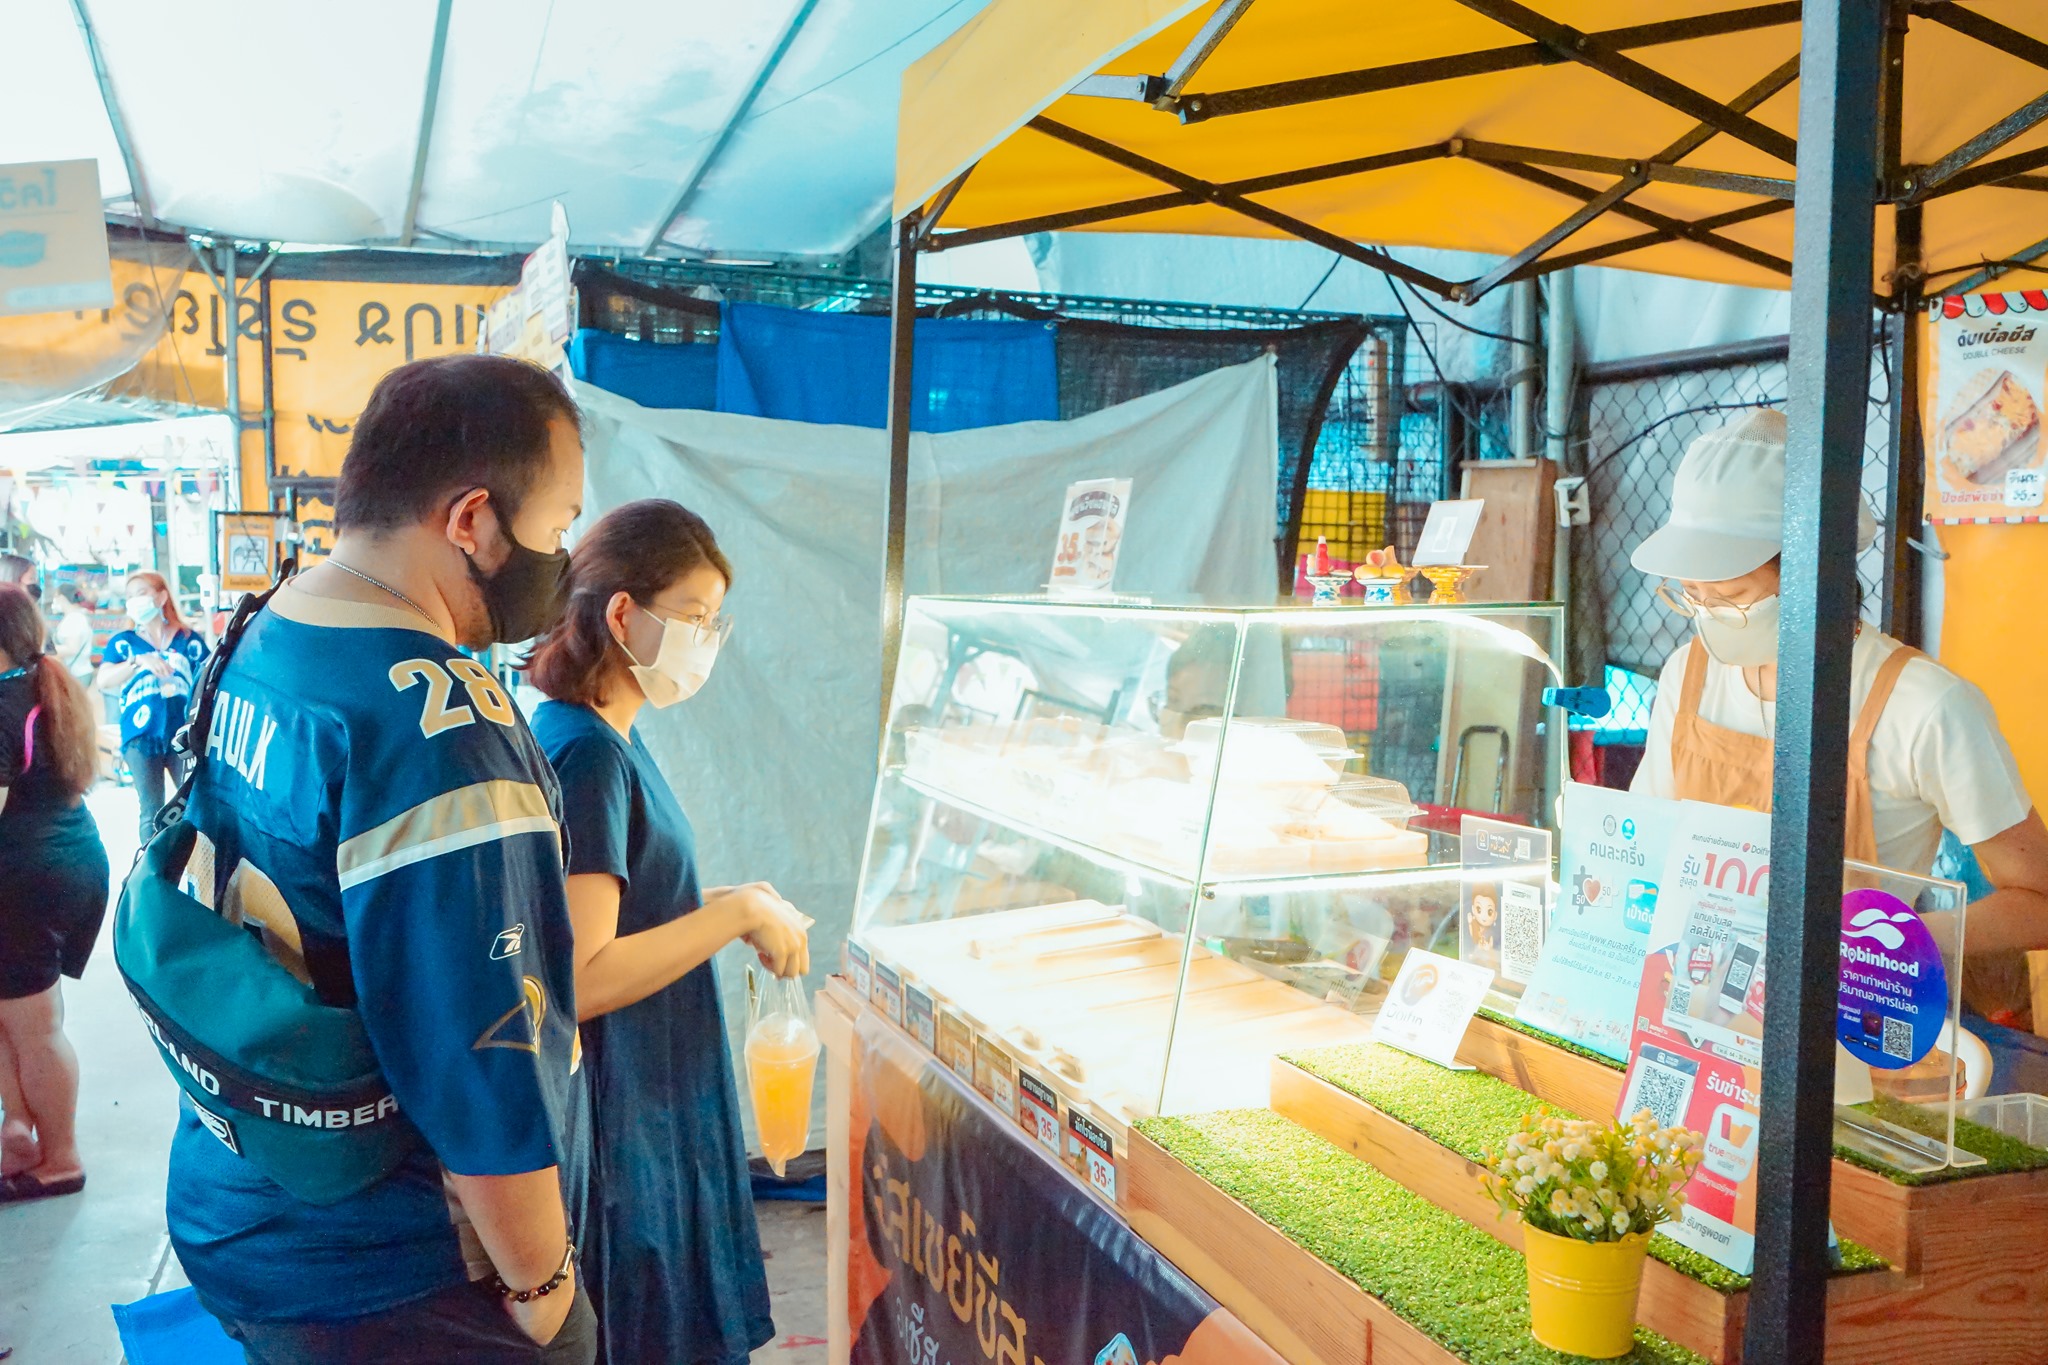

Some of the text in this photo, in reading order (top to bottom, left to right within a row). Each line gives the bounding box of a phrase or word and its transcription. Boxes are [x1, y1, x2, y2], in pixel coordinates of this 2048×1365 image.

[1963, 346, 2026, 360] DOUBLE CHEESE
[388, 657, 514, 739] 28
[204, 690, 278, 792] AULK
[1589, 841, 1645, 867] คนละครึ่ง
[1682, 854, 1701, 876] รับ
[1602, 886, 1611, 896] 50
[1679, 876, 1698, 889] สูงสุด
[1576, 895, 1585, 905] 50
[1839, 941, 1919, 978] Robinhood
[1842, 970, 1912, 998] ราคาเท่าหน้าร้าน
